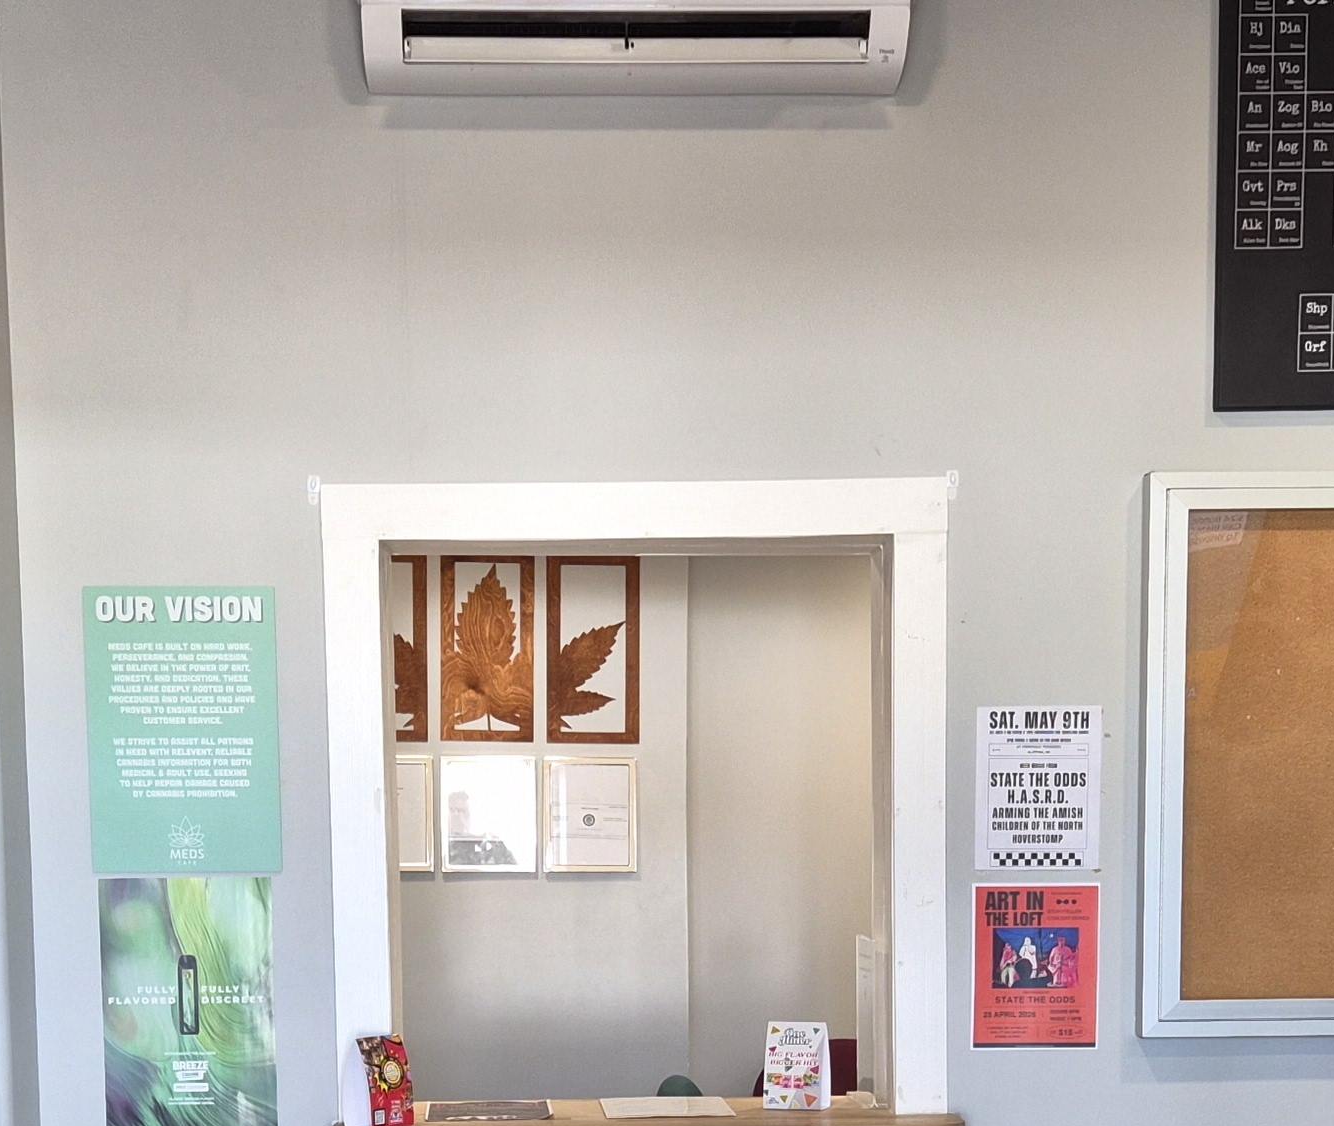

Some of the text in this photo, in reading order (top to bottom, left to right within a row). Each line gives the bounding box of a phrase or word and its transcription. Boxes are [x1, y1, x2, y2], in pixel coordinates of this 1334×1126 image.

[1245, 62, 1266, 74] Ace
[1277, 100, 1300, 115] Zog
[1305, 302, 1328, 316] Shp
[95, 595, 263, 623] OUR VISION
[989, 711, 1089, 729] SAT. MAY 9TH
[990, 773, 1086, 787] STATE THE ODDS
[1007, 789, 1069, 804] H.A.S.R.D.
[992, 807, 1083, 819] ARMING THE AMISH
[992, 821, 1083, 831] CHILDREN OF THE NORTH
[1012, 834, 1064, 844] HOVERSTOMP
[170, 849, 204, 859] MEDS
[984, 891, 1044, 910] ART IN
[984, 912, 1044, 926] THE LOFT
[137, 985, 240, 994] FULLY FULLY
[107, 996, 265, 1005] FLAVORED DISCREET
[995, 996, 1024, 1004] STATE
[1049, 996, 1076, 1004] ODDS
[172, 1060, 209, 1070] BREEZE
